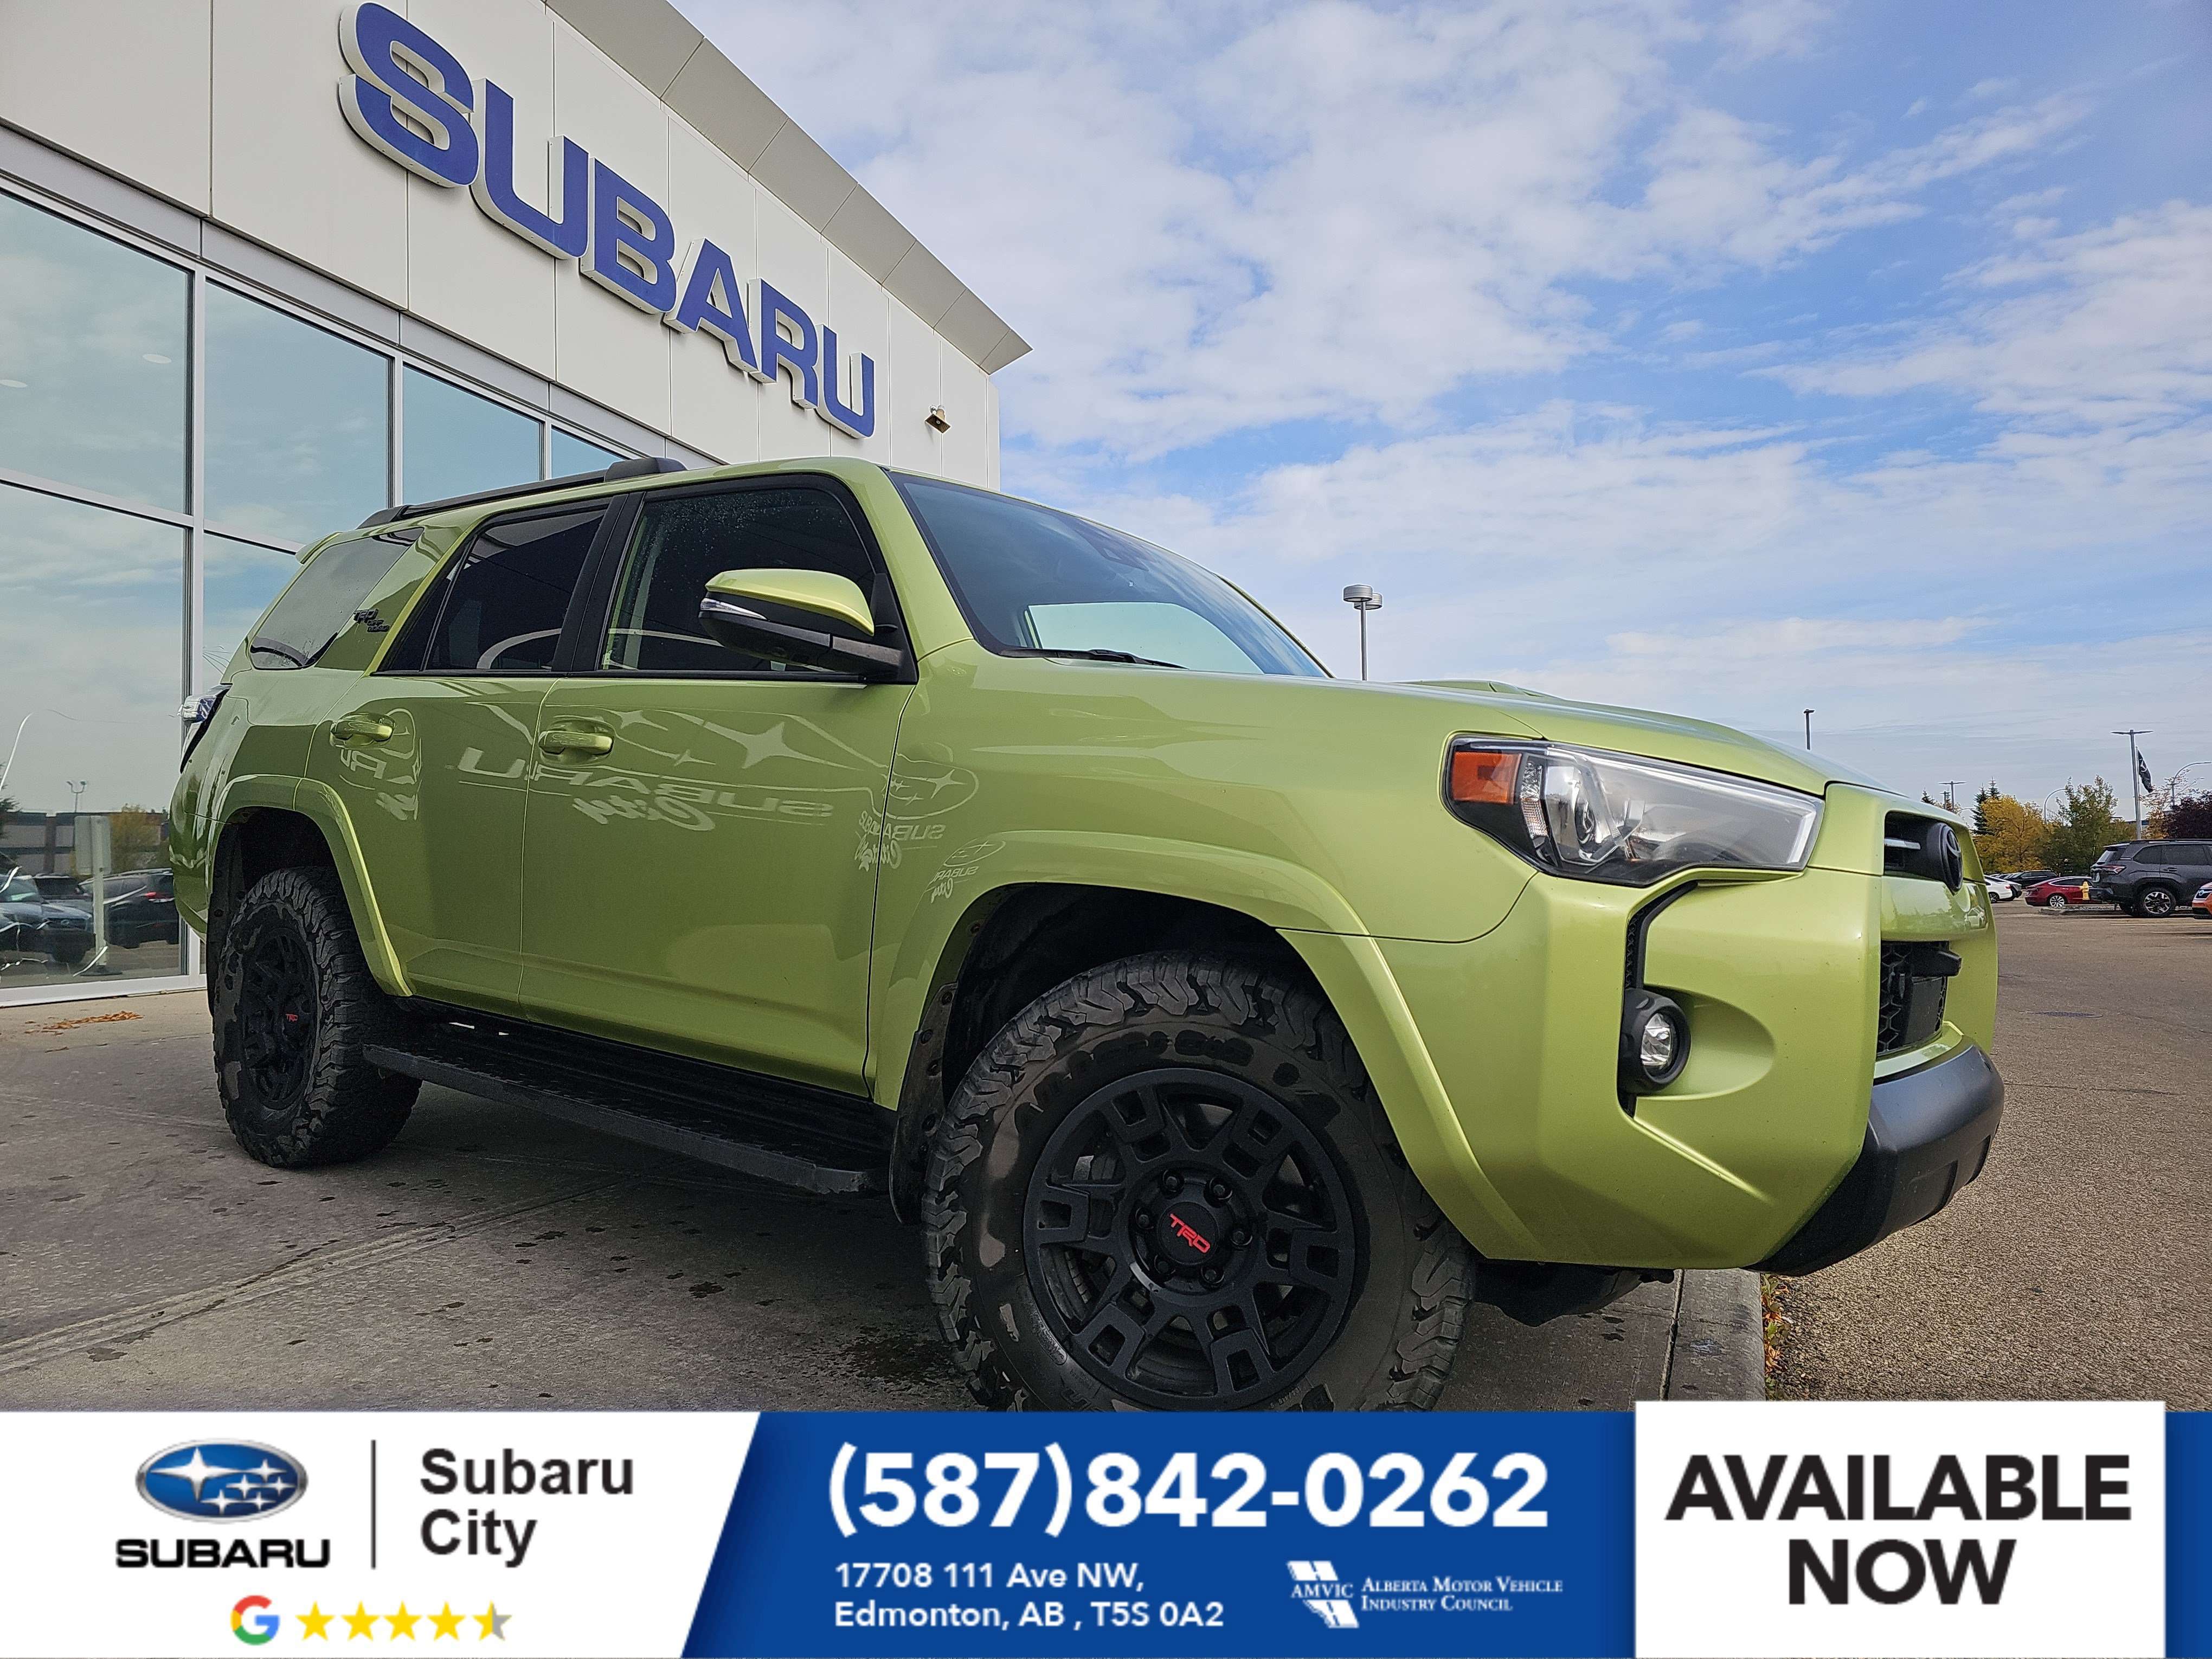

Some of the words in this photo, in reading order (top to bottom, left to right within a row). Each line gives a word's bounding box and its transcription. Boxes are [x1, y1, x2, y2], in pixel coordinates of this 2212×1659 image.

[340, 2, 874, 438] SUBARU
[286, 1013, 299, 1022] TRD
[1170, 1213, 1211, 1253] TRD
